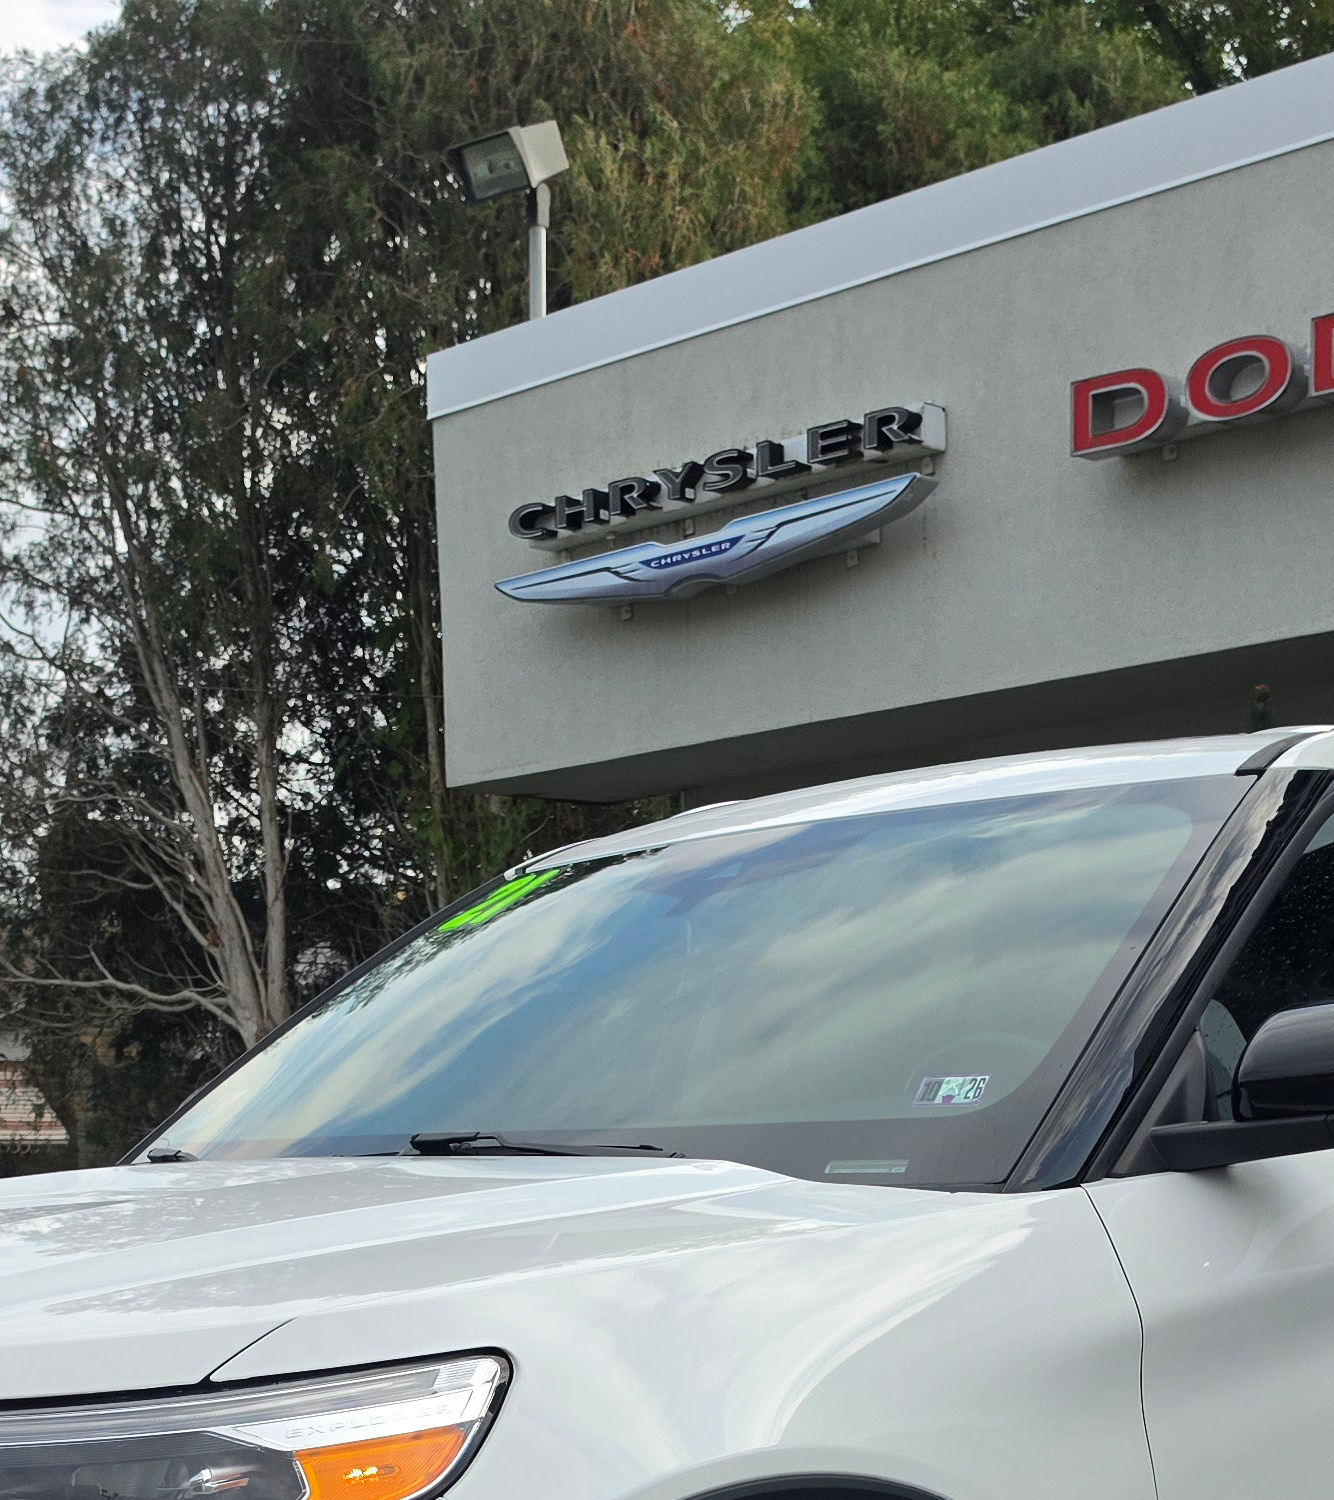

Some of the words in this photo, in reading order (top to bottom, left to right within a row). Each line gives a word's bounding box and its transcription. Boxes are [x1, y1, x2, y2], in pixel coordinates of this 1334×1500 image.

[508, 405, 923, 541] CHRYSLER
[650, 542, 731, 567] CHRYSLER
[963, 1077, 987, 1099] 26
[285, 1404, 453, 1439] EXPLORER
